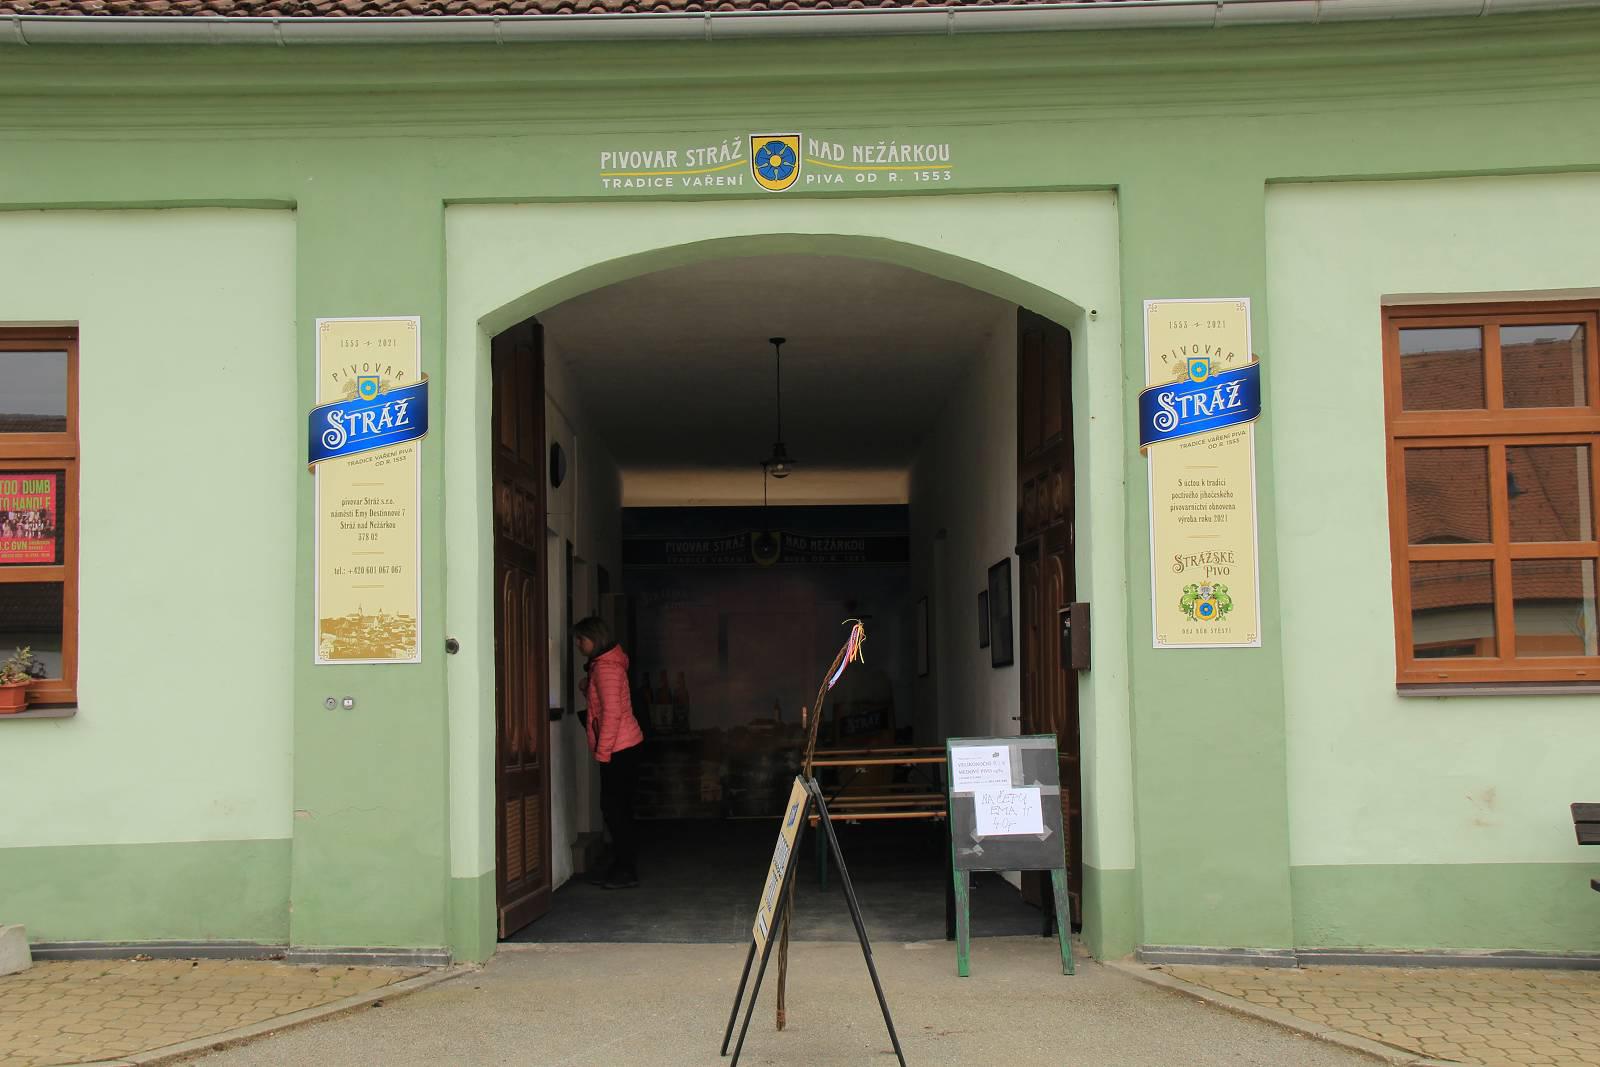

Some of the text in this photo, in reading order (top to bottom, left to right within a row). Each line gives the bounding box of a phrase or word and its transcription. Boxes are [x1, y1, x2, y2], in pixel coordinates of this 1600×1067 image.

[601, 136, 949, 169] PIVOVAR STRÁŽ NAD NEŽÁRKOU
[603, 171, 951, 188] TRADICE VAŘENÍ PIVA OD R. 1553
[1169, 320, 1226, 328] 1553 2021
[340, 338, 396, 348] 1553 2021
[1160, 344, 1234, 364] PIVOVAR
[332, 362, 404, 382] PIVOVAR
[1153, 380, 1241, 432] STRÁŽ
[322, 399, 409, 450] STRÁŽ
[1180, 438, 1206, 449] TRADICE
[1231, 430, 1246, 438] PIVA
[347, 456, 373, 466] TRADICE
[398, 447, 413, 455] PIVA
[393, 455, 406, 463] 1553
[23, 479, 50, 495] DUMB
[1178, 478, 1183, 486] S
[1201, 477, 1206, 486] k
[341, 497, 361, 507] pivovar
[363, 497, 380, 505] Stráž
[1208, 502, 1236, 510] obnovena
[330, 509, 353, 517] náměstí
[355, 508, 367, 519] Emy
[1198, 514, 1212, 522] roku
[1213, 514, 1228, 522] 2021
[340, 520, 396, 529] Stráž nad Nežárkou
[1172, 550, 1234, 574] STRÁŽSKÉ
[348, 566, 365, 575] +420
[1204, 566, 1230, 578] PIVO
